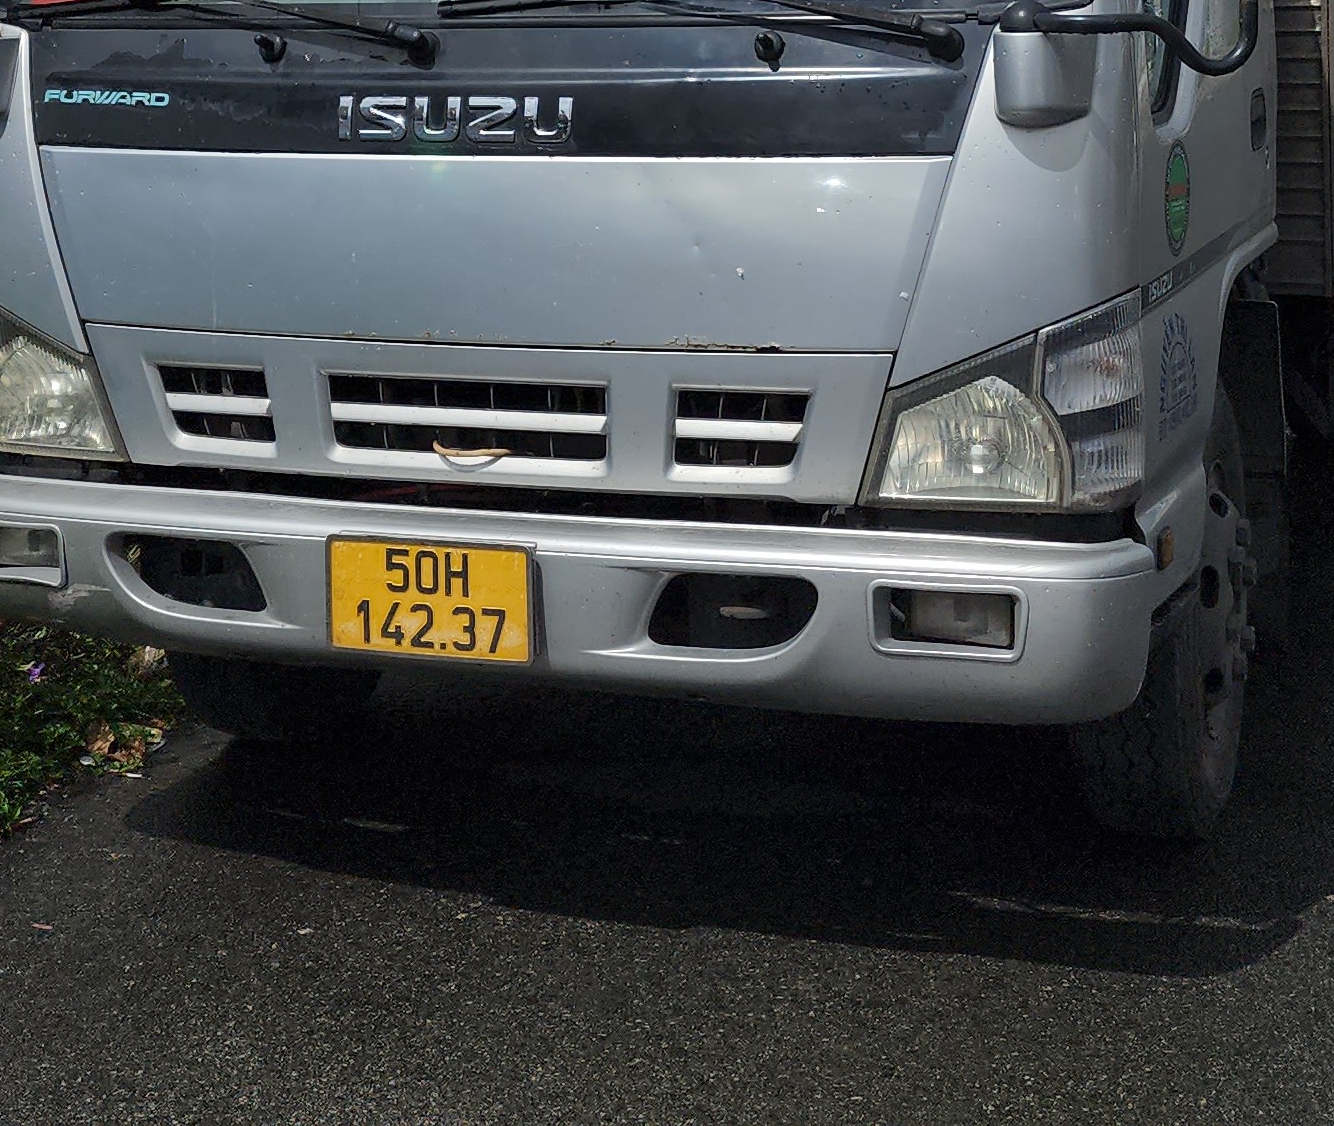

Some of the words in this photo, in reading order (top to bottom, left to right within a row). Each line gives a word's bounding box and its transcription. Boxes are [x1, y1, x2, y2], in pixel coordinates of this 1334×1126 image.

[43, 88, 170, 107] FORWARD
[338, 95, 574, 144] ISUZU
[385, 547, 470, 598] 50H
[356, 599, 507, 654] 142.37
